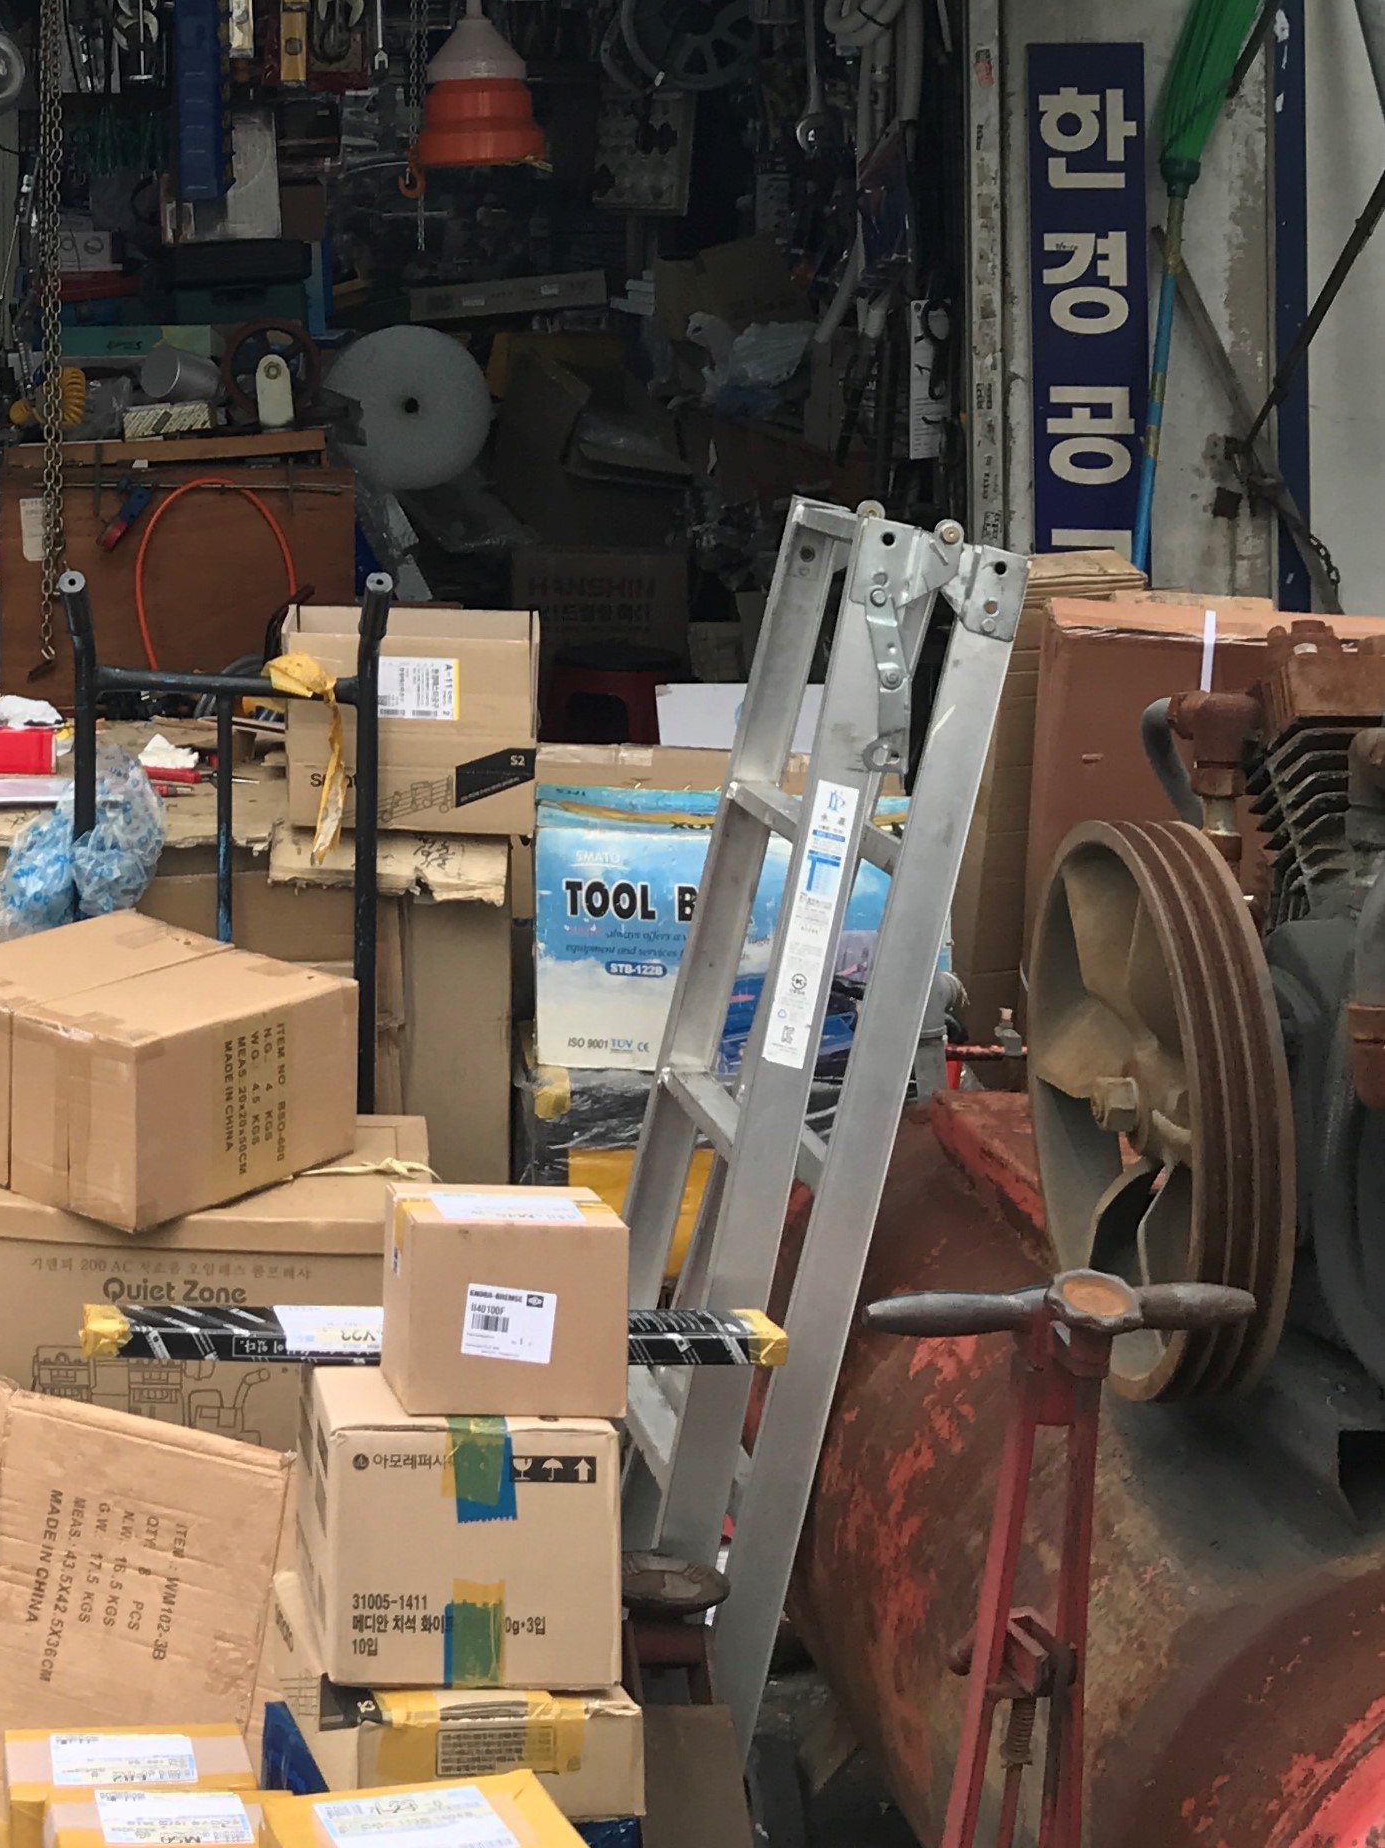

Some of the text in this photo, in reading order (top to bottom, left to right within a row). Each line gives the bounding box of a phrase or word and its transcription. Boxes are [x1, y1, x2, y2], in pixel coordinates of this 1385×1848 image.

[1038, 86, 1138, 550] 한경공
[575, 849, 621, 865] SMATO
[565, 880, 657, 921] TOOL
[617, 944, 637, 956] and
[275, 1023, 287, 1058] ITEM
[568, 1037, 586, 1049] ISO
[587, 1038, 609, 1050] 9001
[224, 1039, 235, 1153] MADE IN CHINA
[251, 1082, 262, 1105] 4.5
[265, 1082, 274, 1092] 4
[264, 1109, 275, 1142] KGS
[80, 1258, 107, 1272] 200
[110, 1260, 132, 1274] AC
[102, 1277, 248, 1304] Quiet Zone
[373, 1452, 455, 1471] 아모레퍼시
[25, 1488, 64, 1624] MADE IN CHINA
[85, 1552, 104, 1586] 17.5
[109, 1555, 128, 1591] 16.5
[78, 1591, 96, 1624] KGS
[102, 1594, 120, 1628] KGS
[127, 1599, 145, 1632] PCS
[352, 1592, 428, 1611] 31005-1411
[352, 1615, 390, 1634] 메디안
[392, 1615, 417, 1634] 치석
[352, 1638, 379, 1657] 10입
